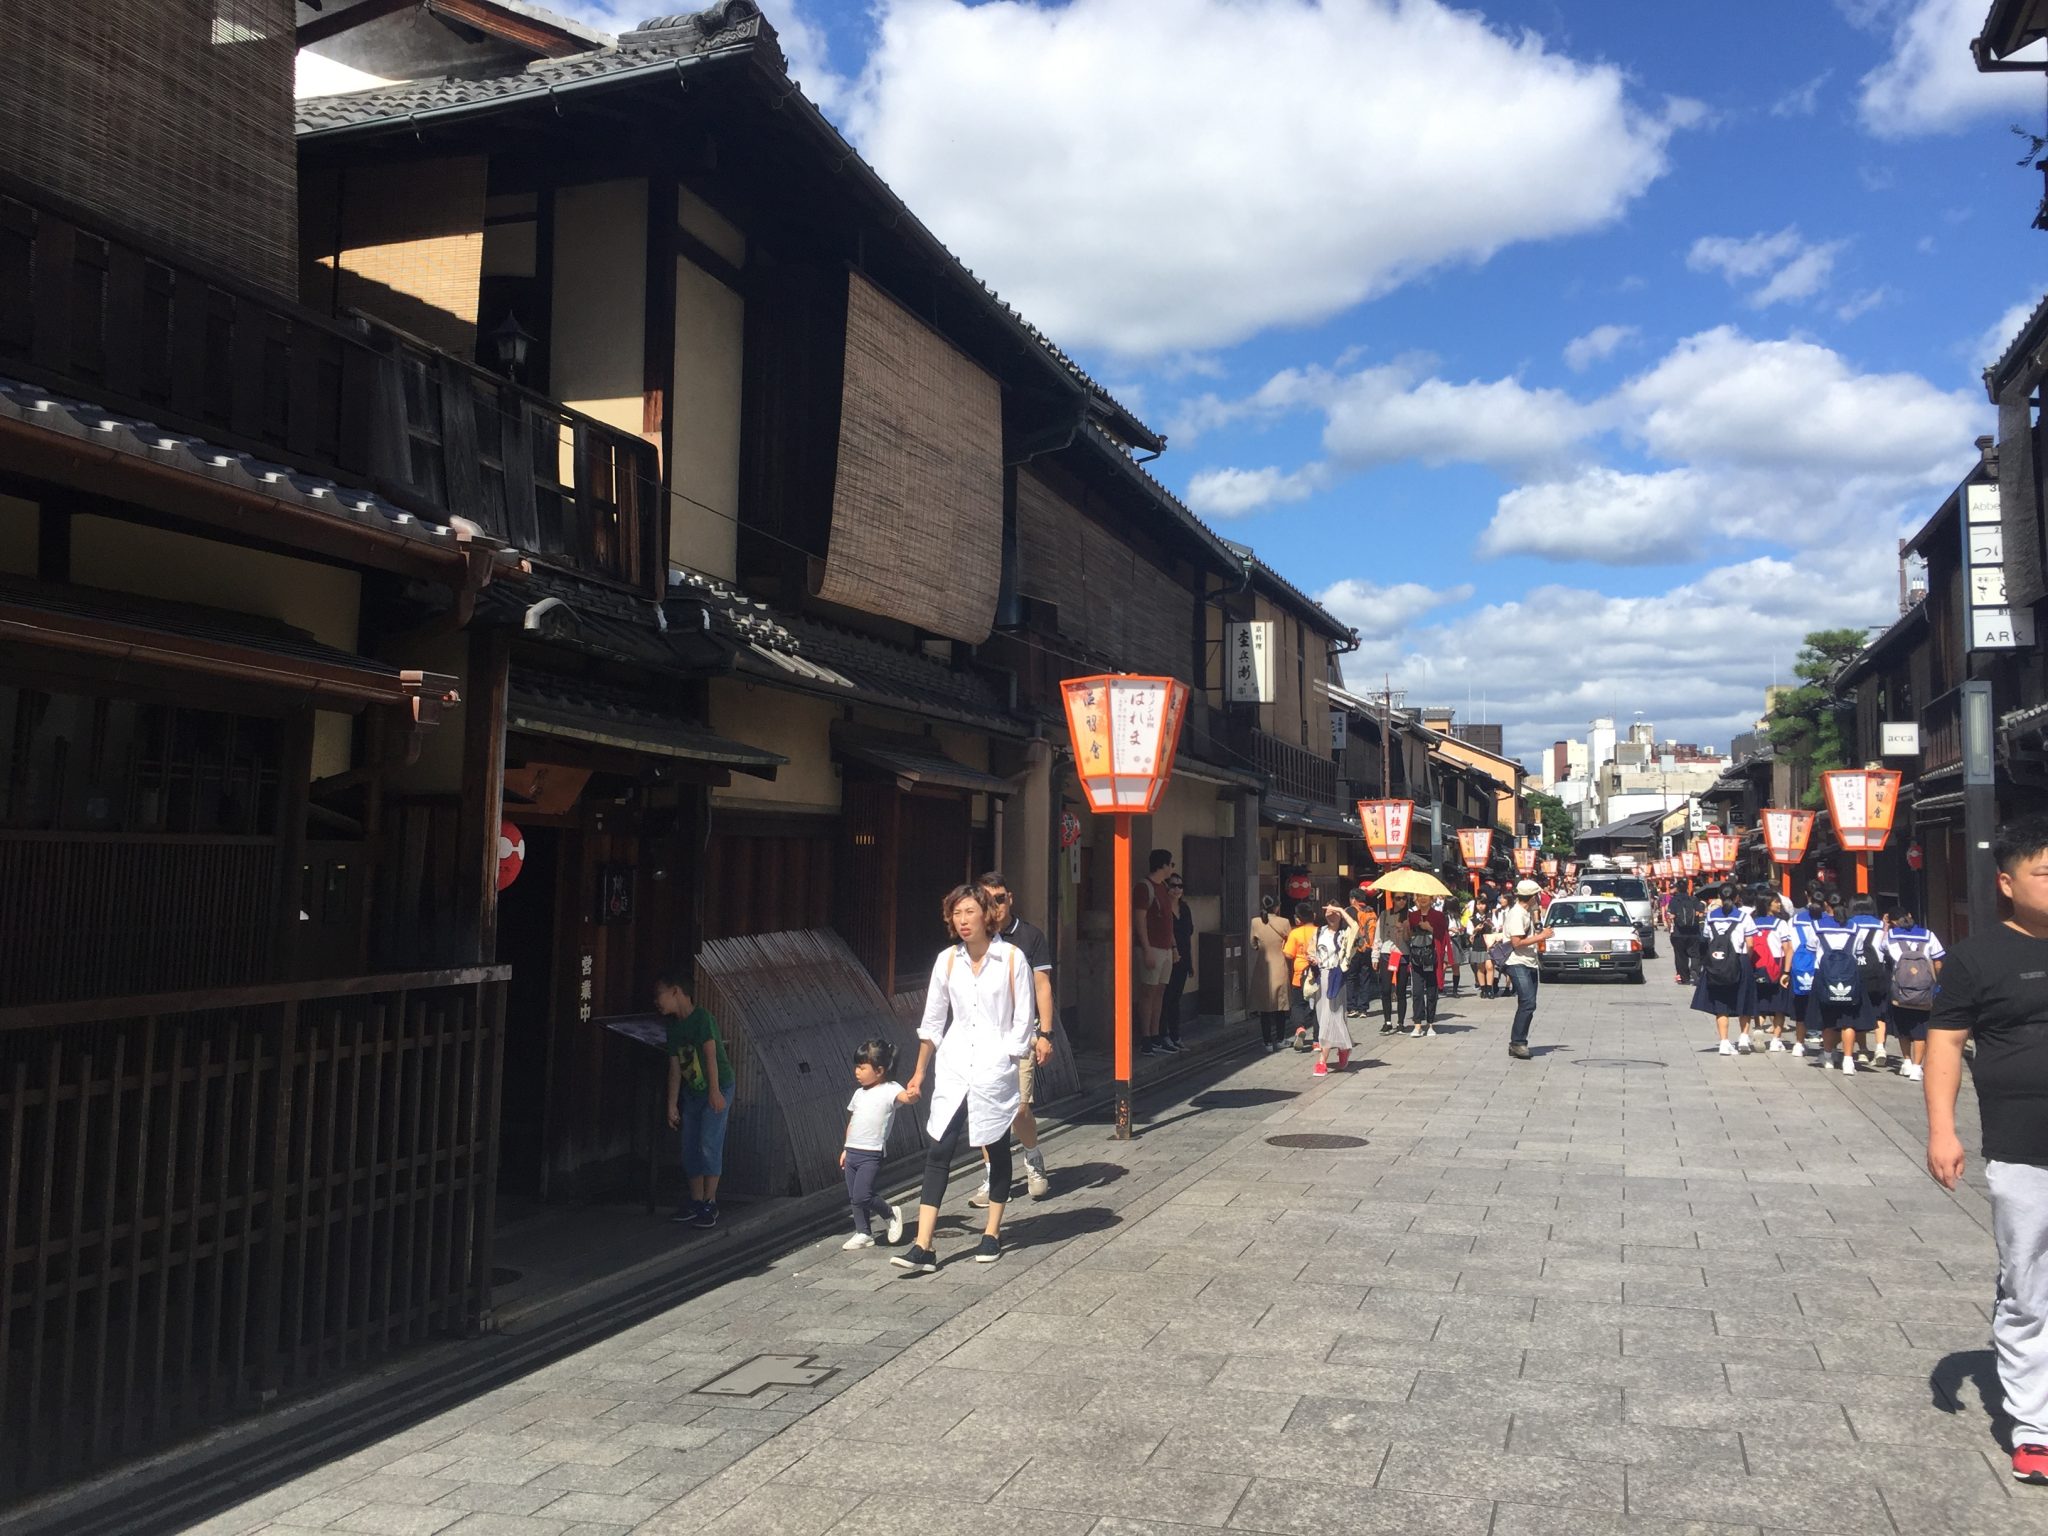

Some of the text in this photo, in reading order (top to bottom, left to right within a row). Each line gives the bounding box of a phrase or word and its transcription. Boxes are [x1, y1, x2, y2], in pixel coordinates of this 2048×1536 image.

[1985, 631, 2023, 643] ARK
[1130, 692, 1145, 746] はれま
[1390, 802, 1402, 842] 月桂冠
[579, 955, 593, 1023] 営業中
